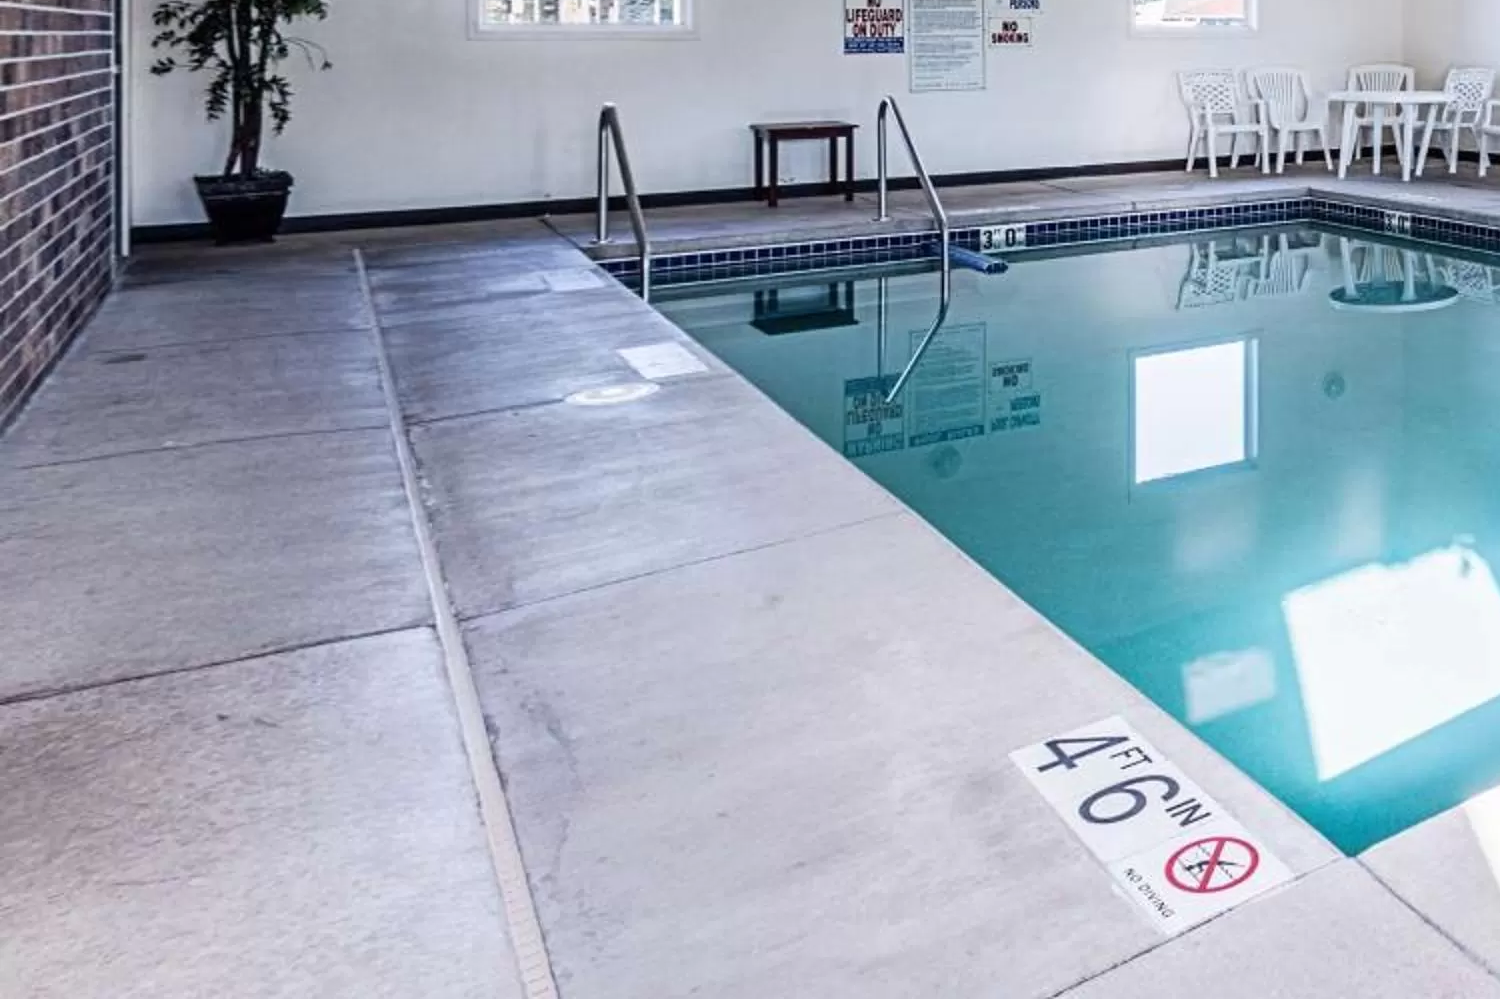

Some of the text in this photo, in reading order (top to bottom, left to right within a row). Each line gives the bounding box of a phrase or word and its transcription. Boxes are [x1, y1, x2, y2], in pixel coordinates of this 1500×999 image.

[846, 8, 903, 22] LIFEGUARD
[853, 22, 896, 37] ON DUTY
[1002, 21, 1018, 32] NO
[991, 33, 1029, 44] SMOKING
[983, 230, 993, 249] 3
[1037, 736, 1153, 773] 4 FT
[1078, 774, 1213, 828] 6 IN
[1123, 867, 1176, 919] NO DIVING
